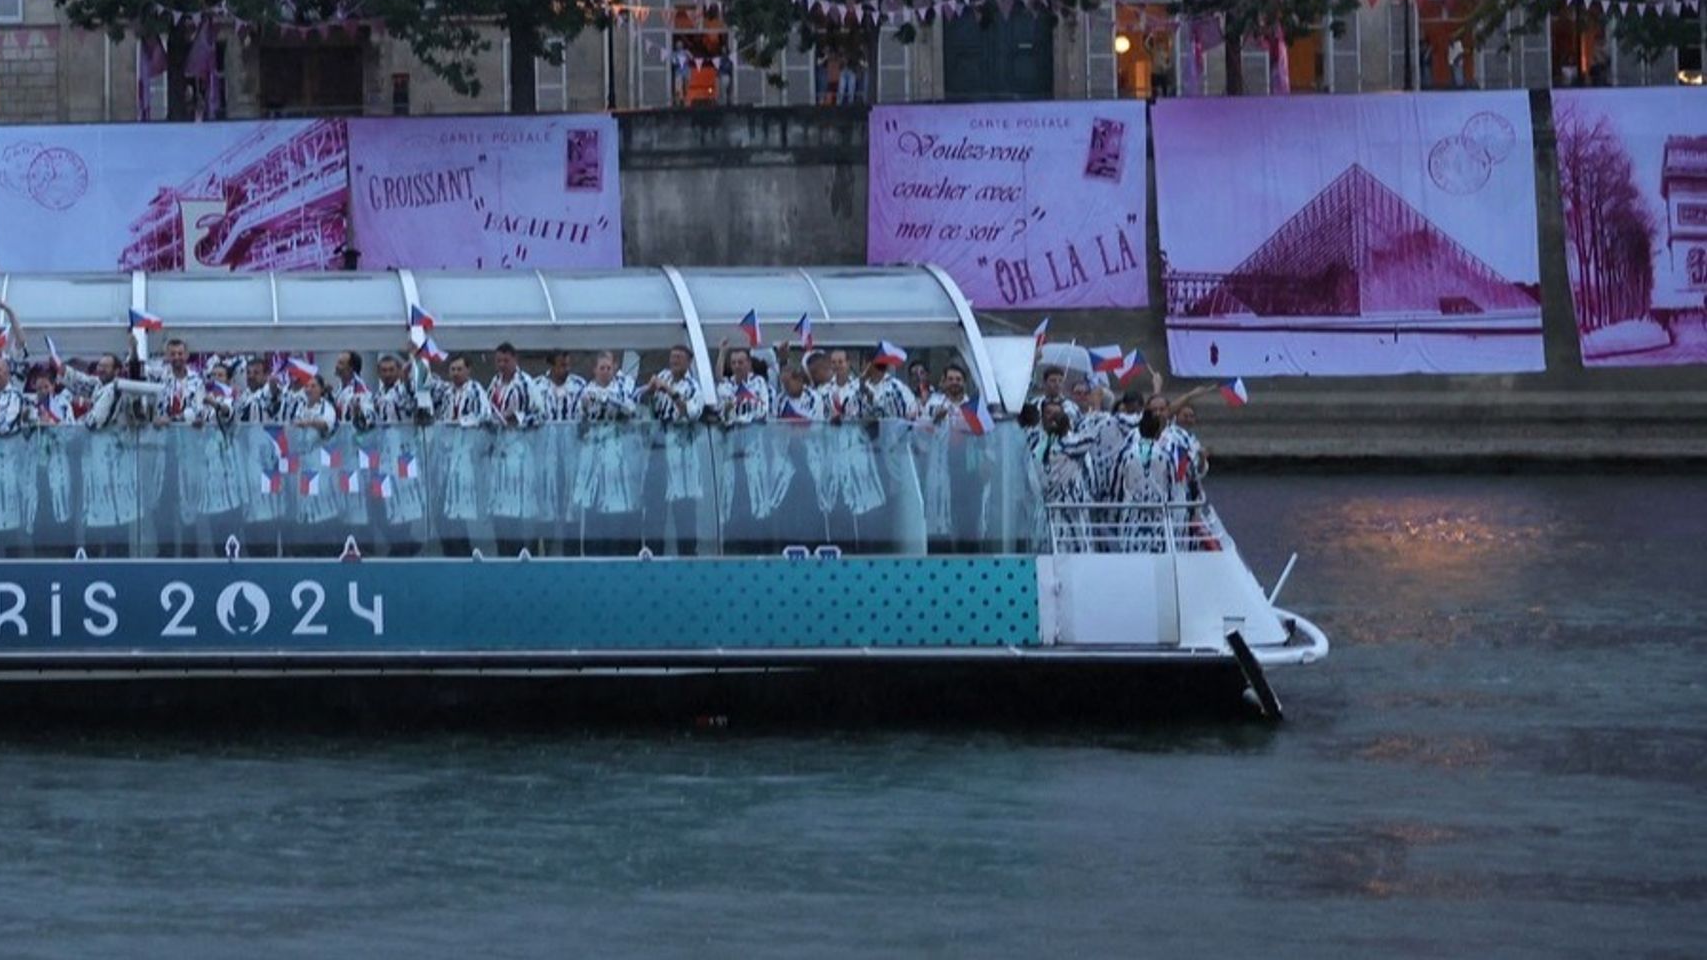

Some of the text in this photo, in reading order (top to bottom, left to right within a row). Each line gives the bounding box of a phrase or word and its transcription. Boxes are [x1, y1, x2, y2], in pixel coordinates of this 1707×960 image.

[892, 177, 1022, 202] coucher avec
[895, 222, 932, 240] moi
[938, 226, 963, 240] ce
[965, 222, 1004, 241] soir
[159, 580, 385, 637] 2024
